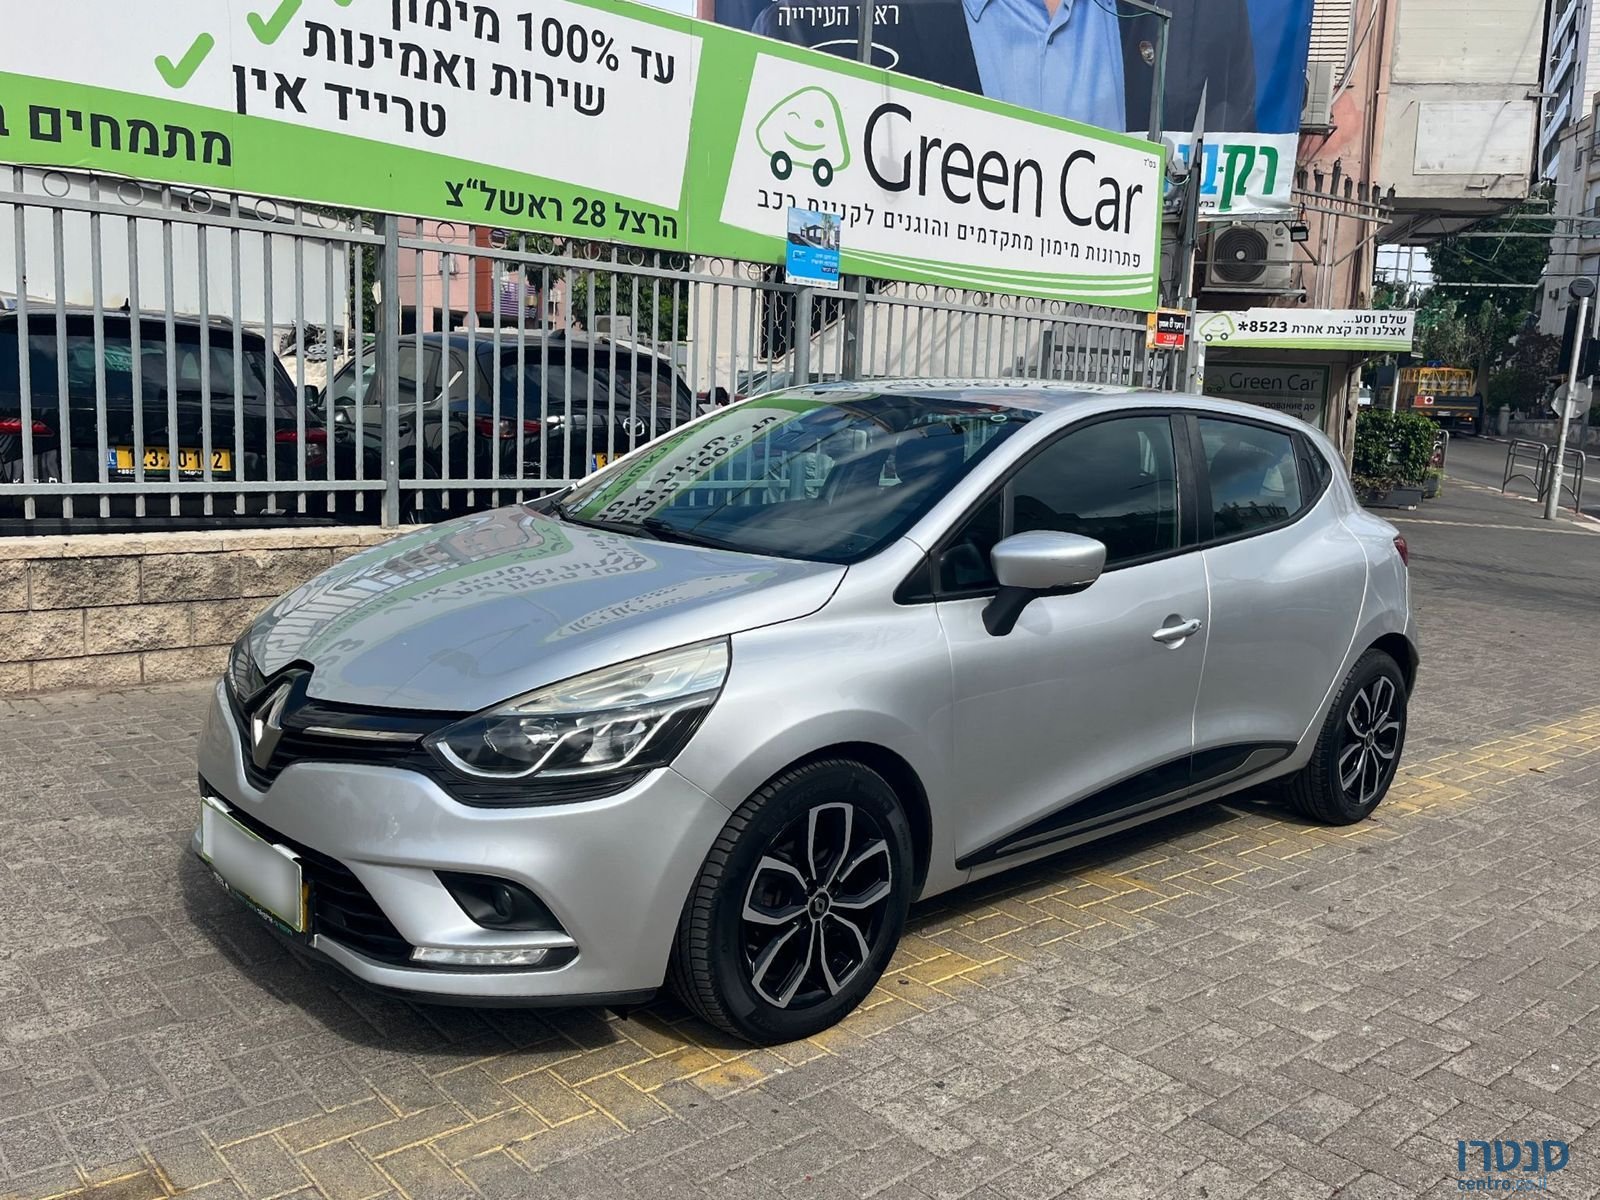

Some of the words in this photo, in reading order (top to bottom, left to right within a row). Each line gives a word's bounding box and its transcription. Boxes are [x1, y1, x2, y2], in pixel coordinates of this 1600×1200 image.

[778, 5, 849, 27] העירייה
[857, 5, 900, 26] רא
[303, 20, 476, 91] ואמינות
[517, 12, 620, 72] 100%
[631, 46, 675, 85] עד
[232, 64, 308, 115] אין
[490, 62, 606, 117] שירות
[324, 82, 447, 138] טרייד
[29, 104, 232, 167] מתמחים
[863, 102, 1043, 218] Green
[1060, 149, 1143, 236] Car
[572, 197, 607, 228] 28
[615, 202, 678, 239] הרצל
[884, 211, 948, 238] והוגנים
[957, 223, 1033, 251] מתקדמים
[1040, 237, 1079, 257] מימון
[1085, 245, 1141, 268] פתרונות
[1291, 324, 1324, 335] אחרת
[1327, 325, 1353, 337] קצת
[1356, 325, 1369, 336] זה
[1373, 325, 1406, 336] אצלנו
[1380, 314, 1408, 325] שלם
[1229, 372, 1282, 390] Green
[1287, 374, 1318, 391] Car
